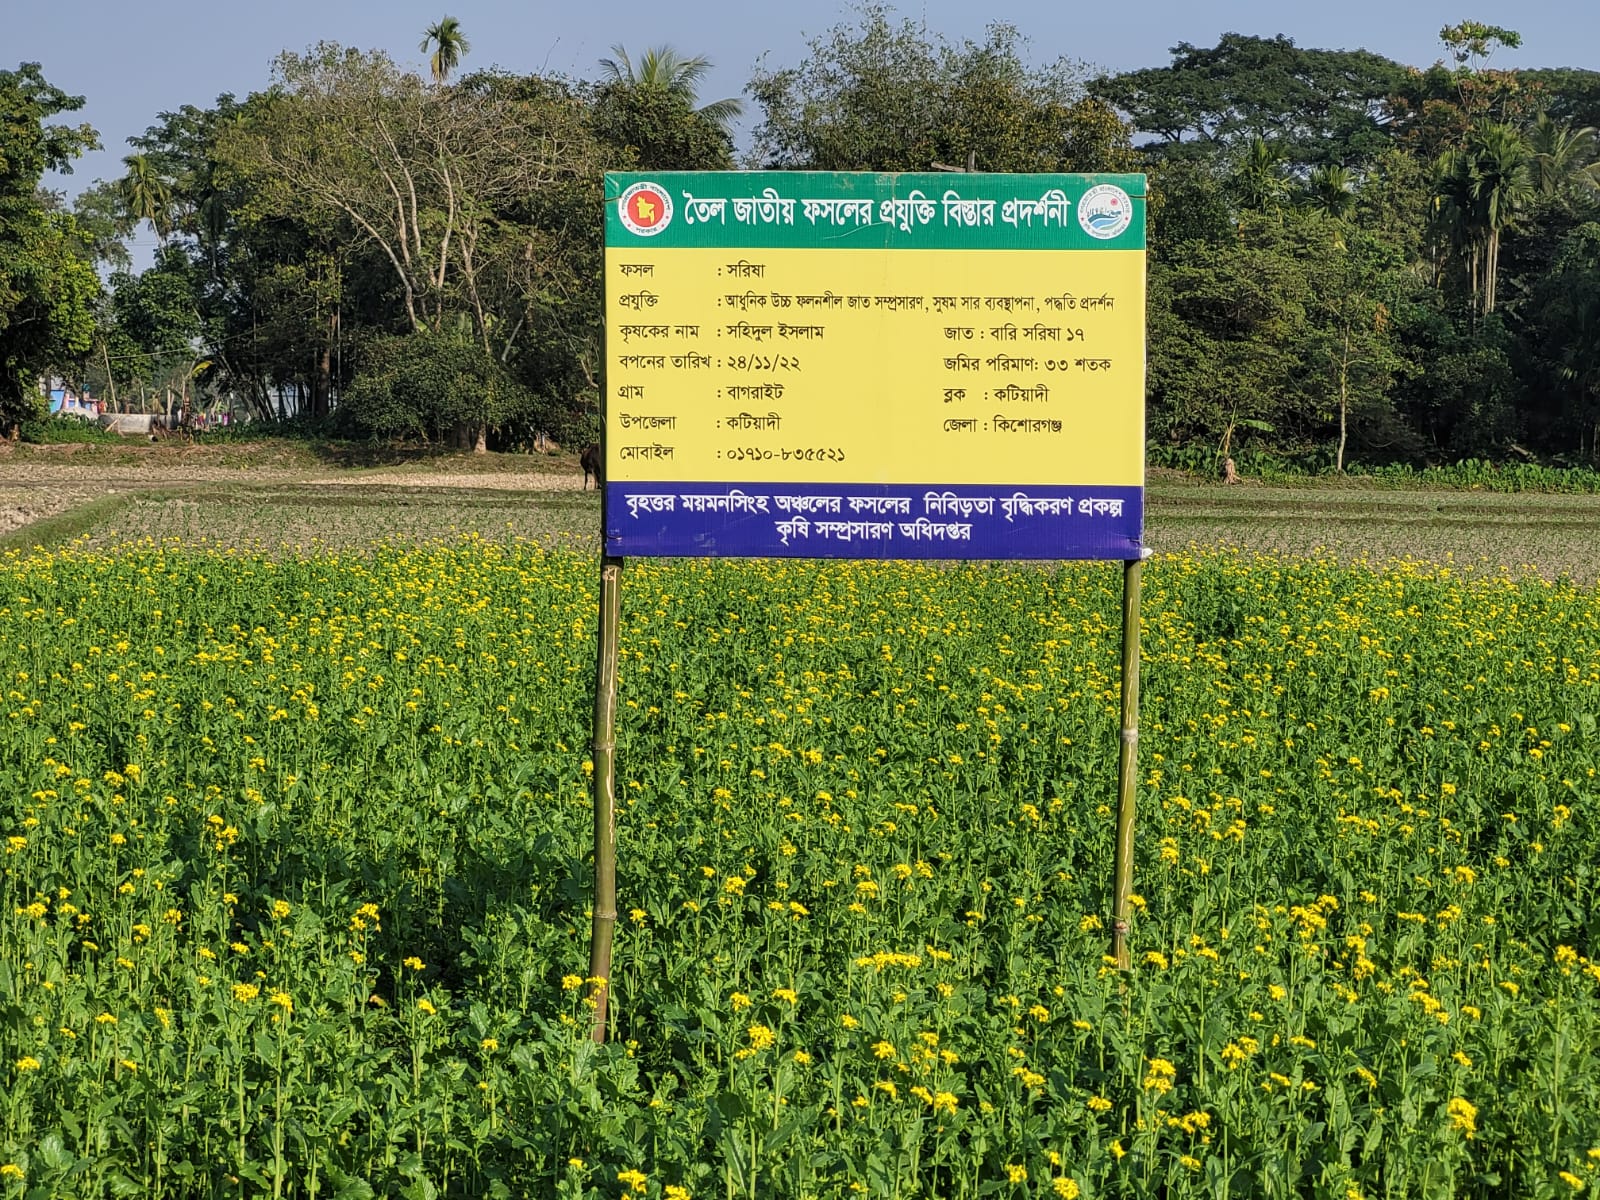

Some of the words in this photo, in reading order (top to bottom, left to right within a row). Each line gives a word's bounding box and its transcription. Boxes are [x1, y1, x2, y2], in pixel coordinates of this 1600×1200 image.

[683, 191, 727, 224] তৈল
[732, 188, 796, 224] জাতীয়
[801, 200, 873, 224] ফসলের
[880, 191, 936, 232] প্রযুক্তি
[942, 191, 996, 226] বিস্তার
[1002, 190, 1070, 227] প্রদর্শনী
[619, 264, 654, 277] ফসল
[726, 260, 765, 278] সরিষা
[619, 290, 659, 311] প্রযুক্তি
[725, 291, 767, 312] আধুনিক
[771, 291, 792, 307] উচ্চ
[795, 291, 843, 308] ফলনশীল
[847, 296, 871, 309] জাত
[933, 297, 957, 313] সুষম
[961, 297, 981, 309] সার
[1045, 293, 1077, 310] পদ্ধতি
[1080, 293, 1114, 311] প্রদর্শন
[619, 325, 670, 344] কৃষকের
[674, 326, 700, 338] নাম
[726, 321, 773, 342] সহিদুল
[777, 322, 825, 339] ইসলাম
[944, 327, 975, 340] জাত
[989, 323, 1018, 340] বারি
[1022, 323, 1061, 341] সরিষা
[1067, 328, 1084, 341] ১৭
[618, 355, 666, 369] বপনের
[670, 351, 712, 369] তারিখ
[728, 354, 801, 372] ২৪/১১/২২
[944, 353, 981, 371] জমির
[1045, 360, 1068, 371] ৩৩
[1074, 358, 1112, 371] শতক
[618, 385, 644, 399] গ্রাম
[726, 383, 785, 400] বাগরাইট
[943, 389, 966, 403] ব্লক
[993, 384, 1050, 402] কটিয়াদী
[619, 412, 677, 429] উপজেলা
[726, 412, 782, 430] কটিয়াদী
[944, 419, 978, 432] জেলা
[992, 415, 1062, 432] কিশোরগঞ্জ
[620, 442, 674, 460] মোবাইল
[727, 448, 845, 462] ০১৭১০-৮৩৫৫২১
[625, 495, 676, 518] বৃহত্তর
[680, 490, 769, 513] ময়মনসিংহ
[774, 496, 842, 512] অঞ্চলের
[847, 497, 912, 513] ফসলের
[923, 492, 995, 518] নিবিড়তা
[1000, 493, 1073, 521] বৃদ্ধিকরণ
[1079, 498, 1124, 517] প্রকল্প
[775, 516, 810, 545] কৃষি
[815, 521, 894, 541] সম্প্রসারণ
[899, 517, 972, 540] অধিদপ্তর
